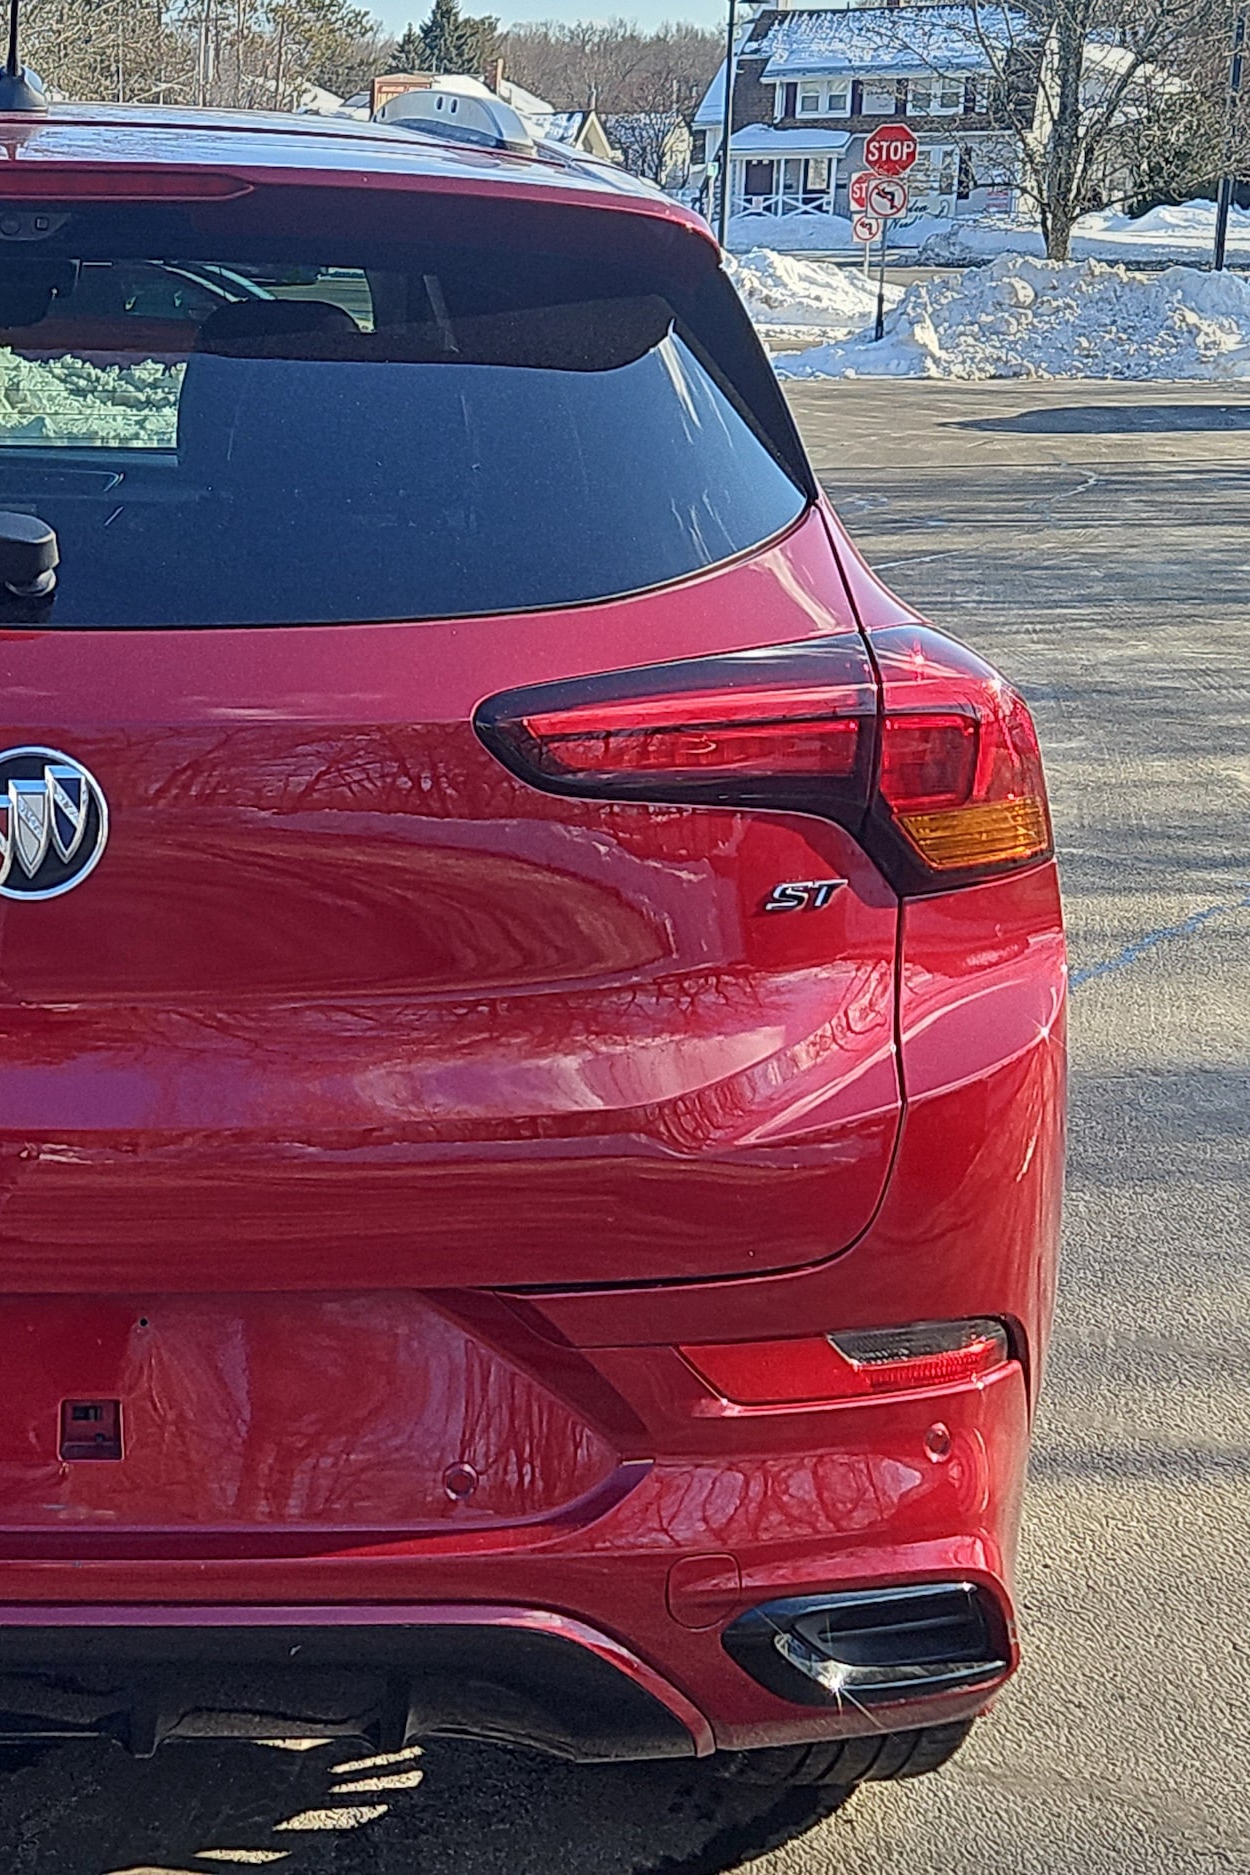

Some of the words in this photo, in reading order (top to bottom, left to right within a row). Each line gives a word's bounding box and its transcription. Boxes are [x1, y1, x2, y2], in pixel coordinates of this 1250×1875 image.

[868, 141, 915, 161] STOP
[852, 183, 868, 199] ST
[764, 878, 849, 912] ST
